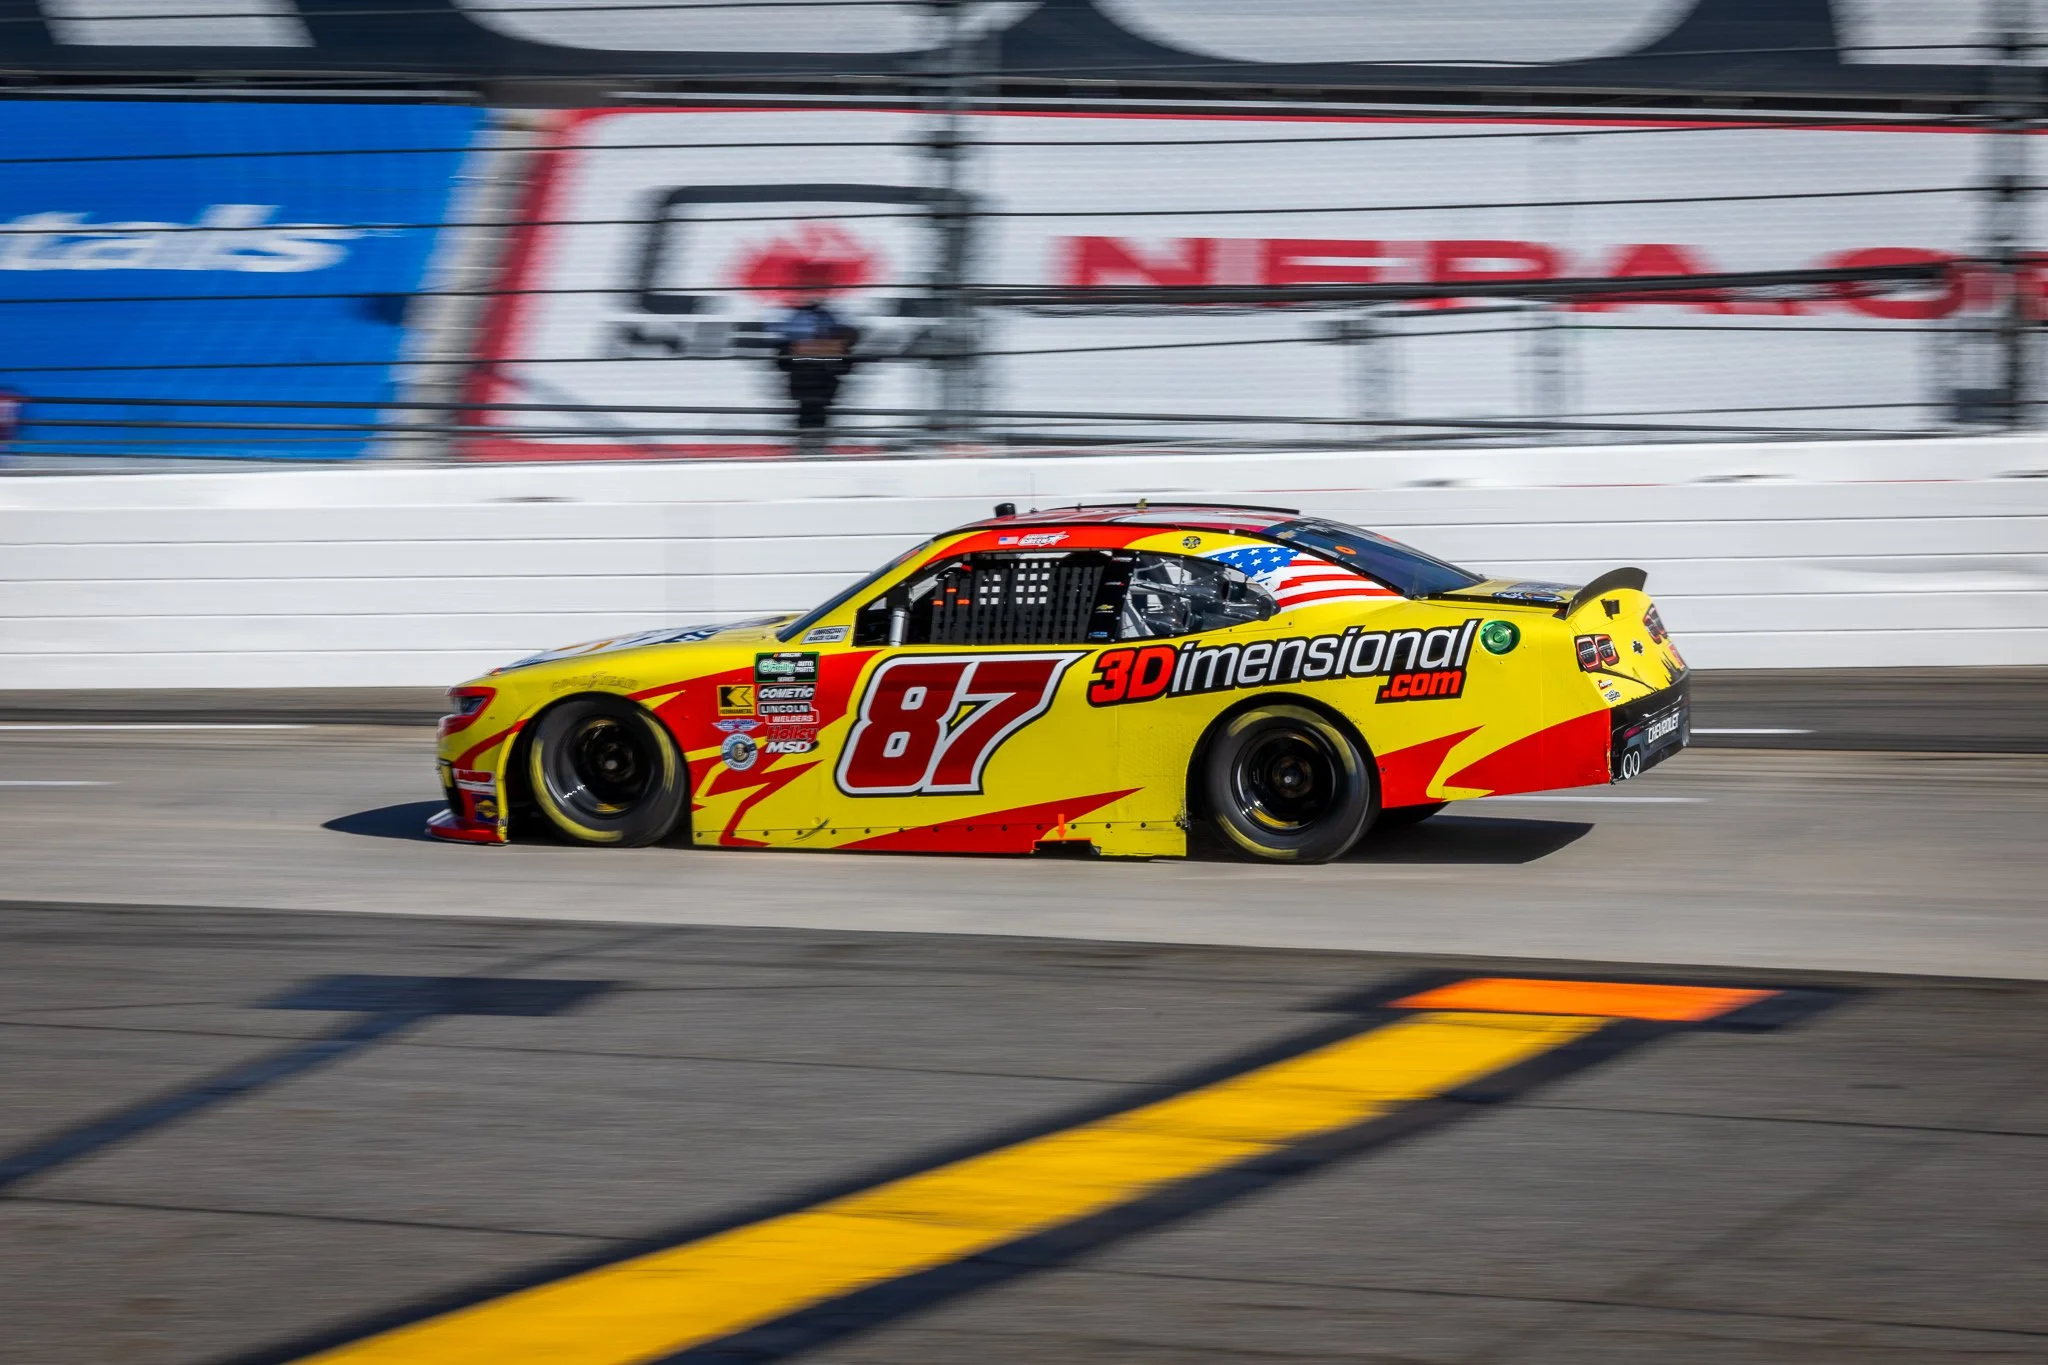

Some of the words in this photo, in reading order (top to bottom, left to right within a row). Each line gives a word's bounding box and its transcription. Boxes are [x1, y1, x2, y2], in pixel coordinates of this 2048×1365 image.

[1048, 236, 2048, 320] NFPA.O
[1088, 619, 1480, 705] 3Dimensional
[758, 686, 815, 699] COMETIC
[1380, 669, 1463, 699] .com
[760, 704, 809, 714] LINCOLN
[771, 714, 814, 723] WELDERS
[835, 651, 1088, 796] 87
[1648, 712, 1680, 744] CHEVROLET
[765, 740, 812, 753] MSD
